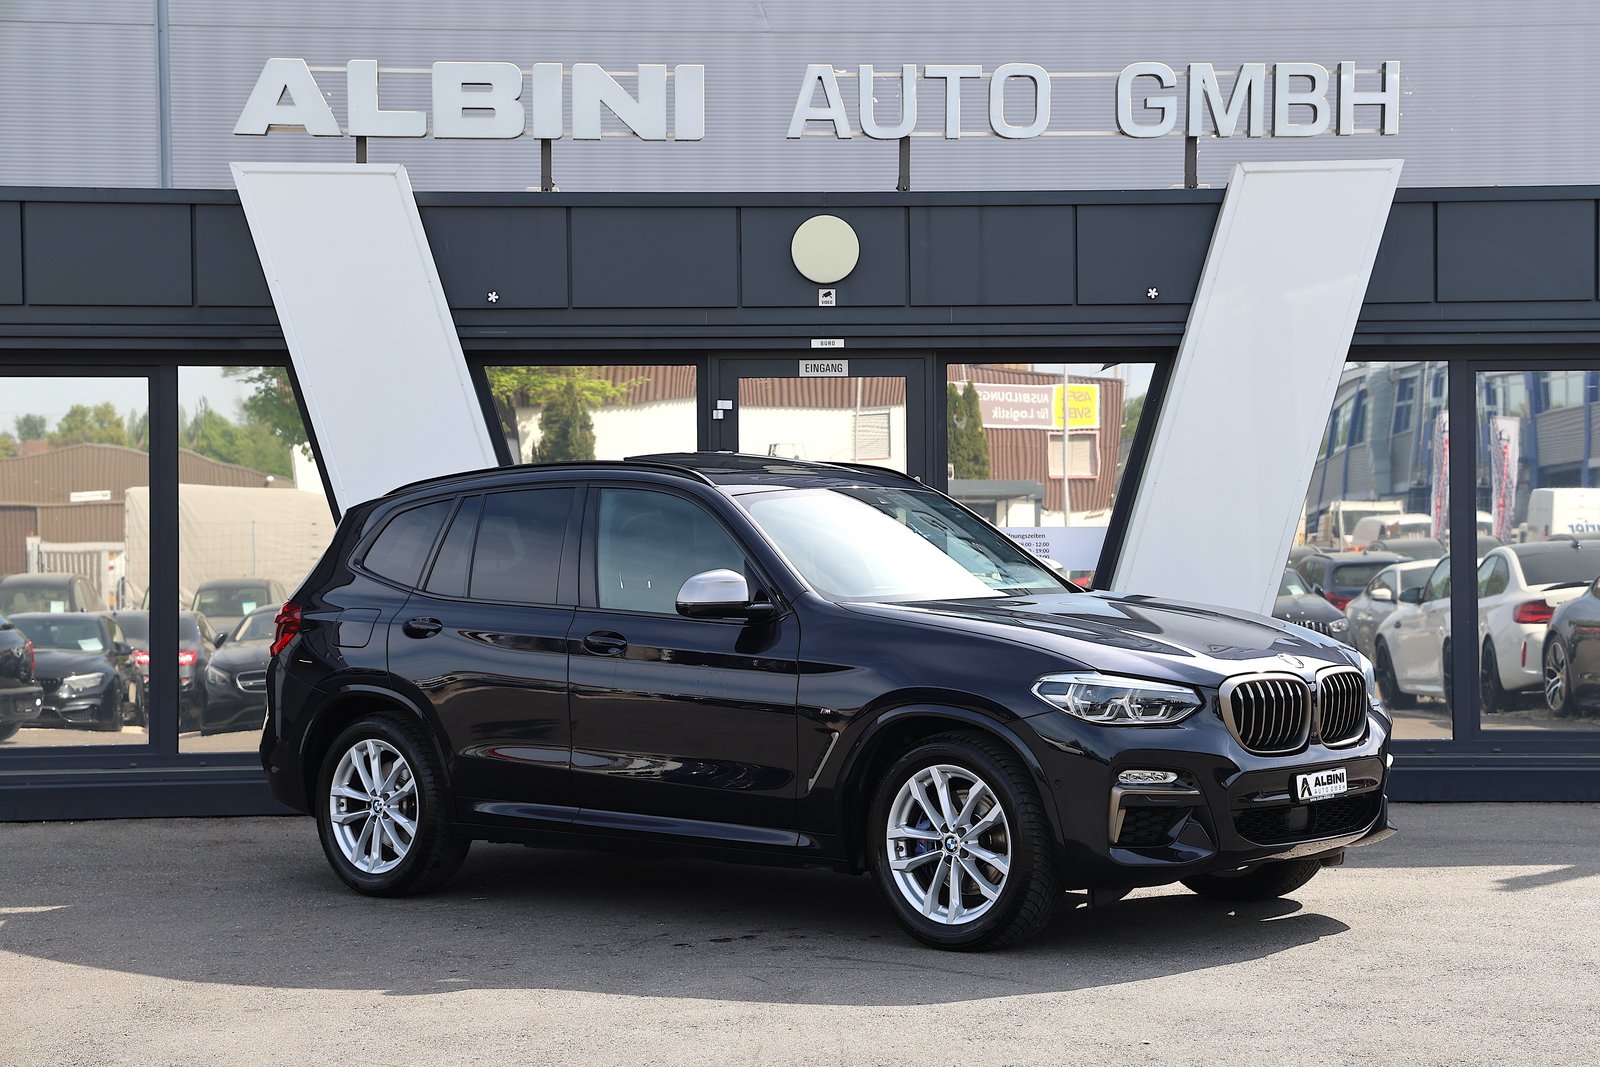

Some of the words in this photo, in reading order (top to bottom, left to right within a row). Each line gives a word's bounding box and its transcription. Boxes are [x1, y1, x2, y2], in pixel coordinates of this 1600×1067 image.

[233, 57, 706, 141] ALBINI
[786, 62, 1052, 140] AUTO
[1116, 60, 1402, 138] GMBH
[805, 363, 843, 373] EINGANG
[1314, 773, 1345, 787] ALBINI
